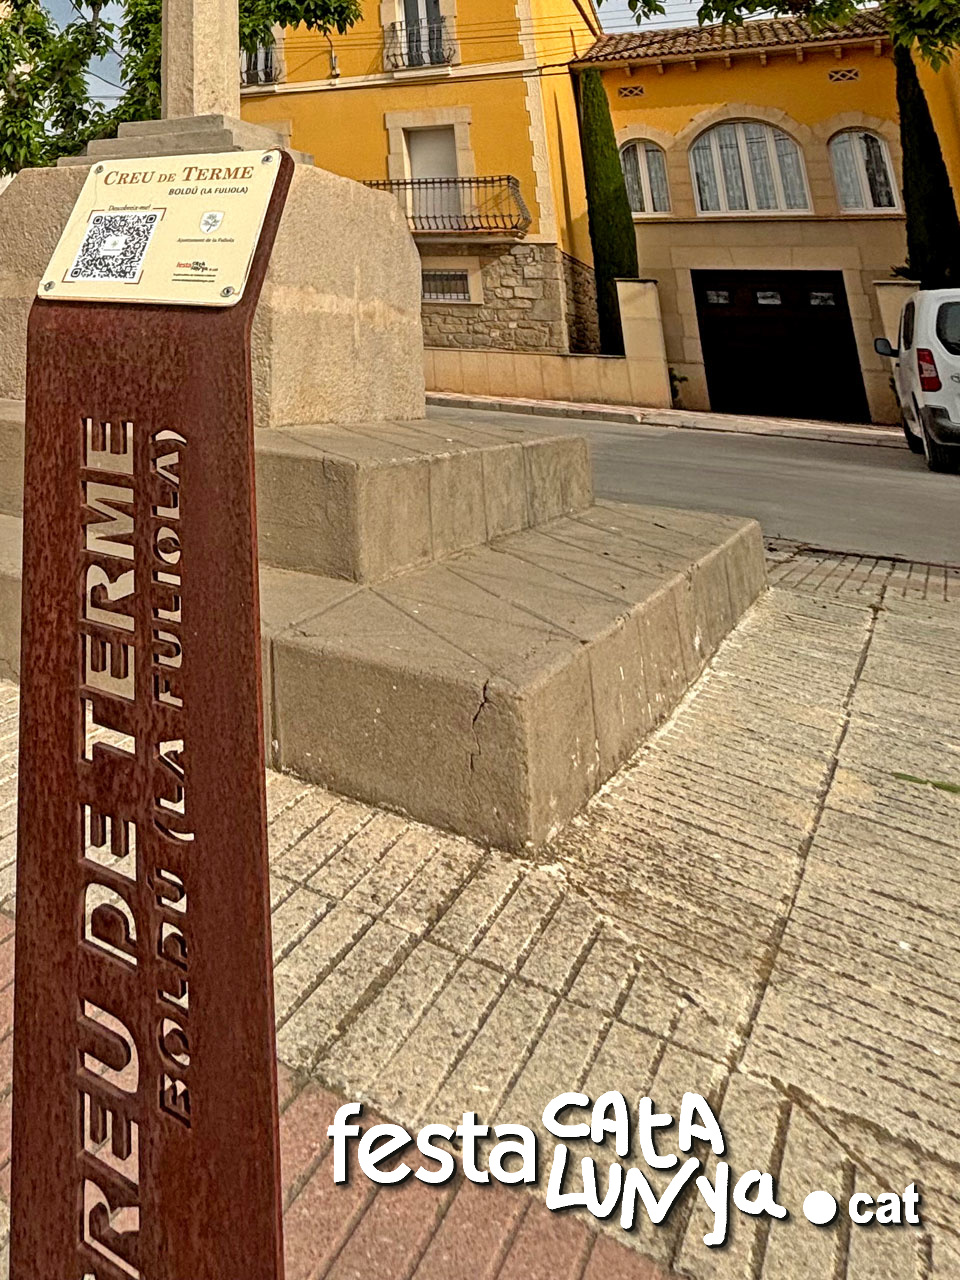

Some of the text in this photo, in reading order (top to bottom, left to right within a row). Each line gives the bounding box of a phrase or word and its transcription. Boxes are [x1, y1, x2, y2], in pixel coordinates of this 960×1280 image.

[104, 166, 254, 185] CREU DE TERME
[168, 186, 198, 195] BOLDÚ
[214, 186, 249, 194] FULIOLA)
[82, 417, 141, 1280] REU DE TERME
[150, 428, 194, 1129] BOLDÚ (LA FULIOLA)
